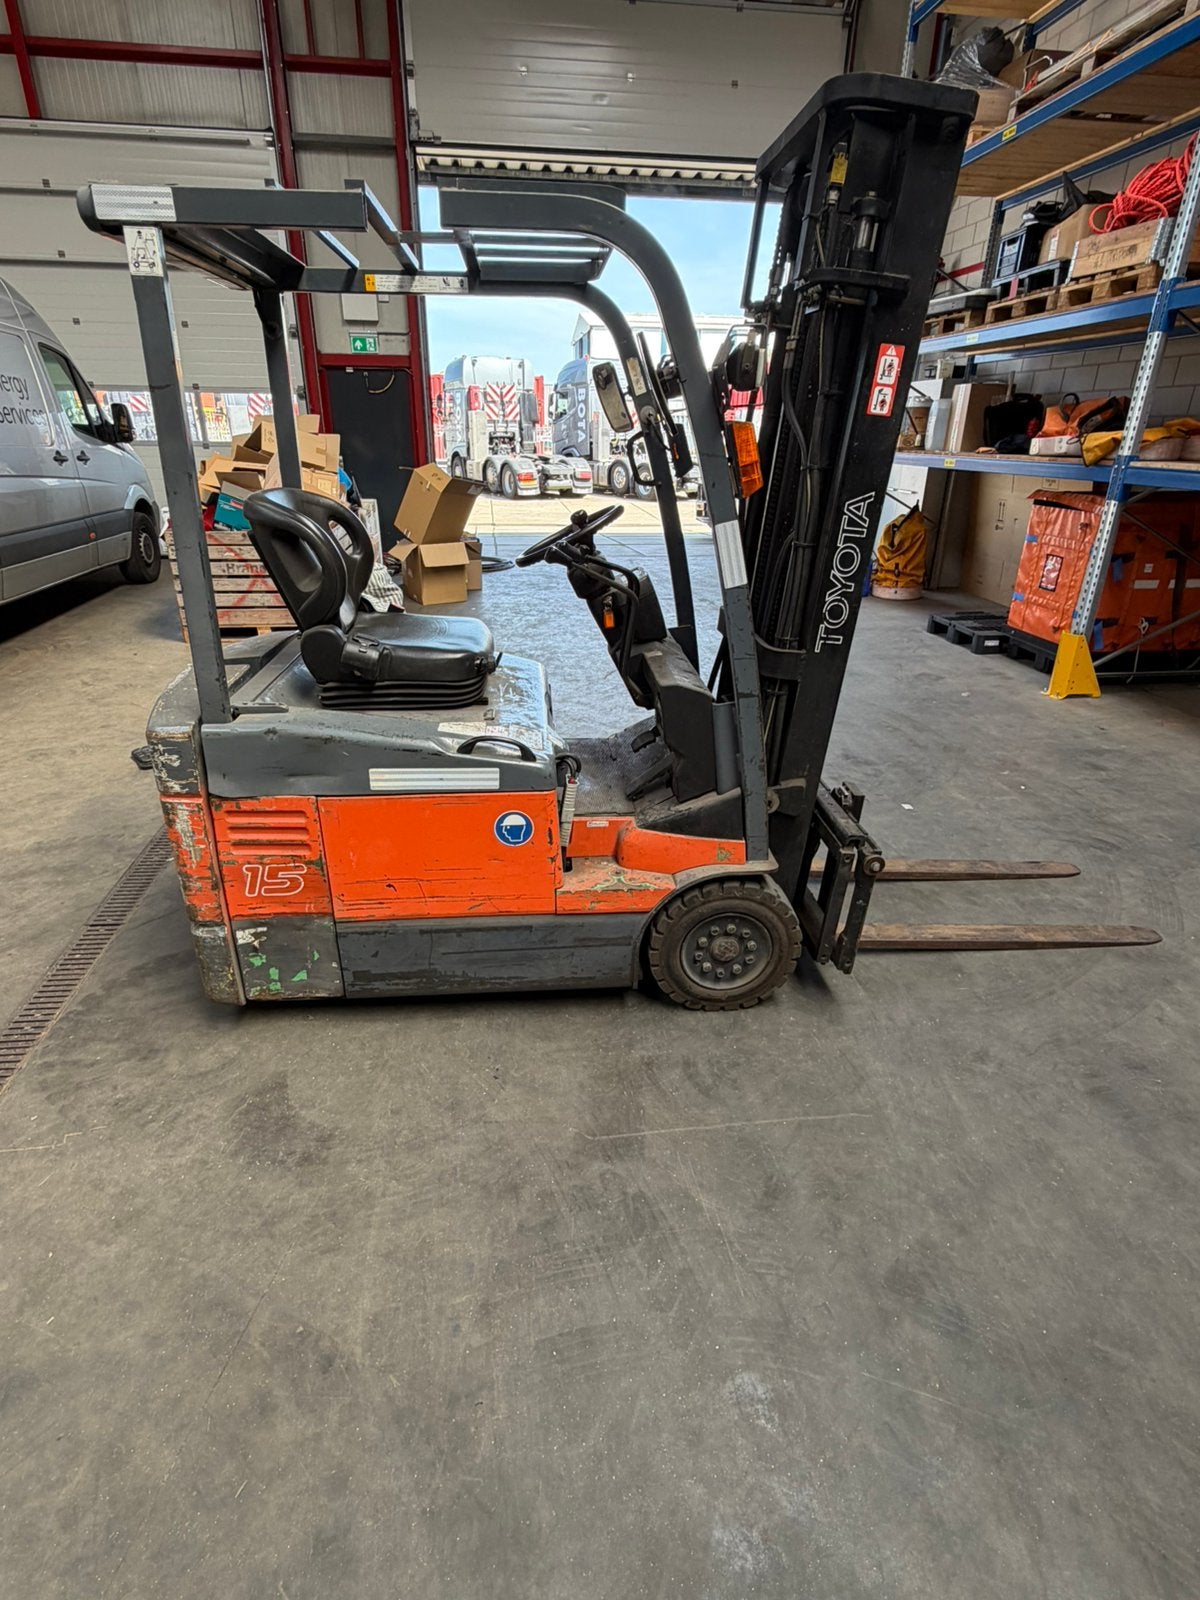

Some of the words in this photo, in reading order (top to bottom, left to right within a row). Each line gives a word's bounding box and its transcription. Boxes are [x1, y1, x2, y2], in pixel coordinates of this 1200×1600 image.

[578, 388, 586, 443] BOTA
[815, 491, 875, 652] TOYOTA
[242, 863, 307, 897] 15
